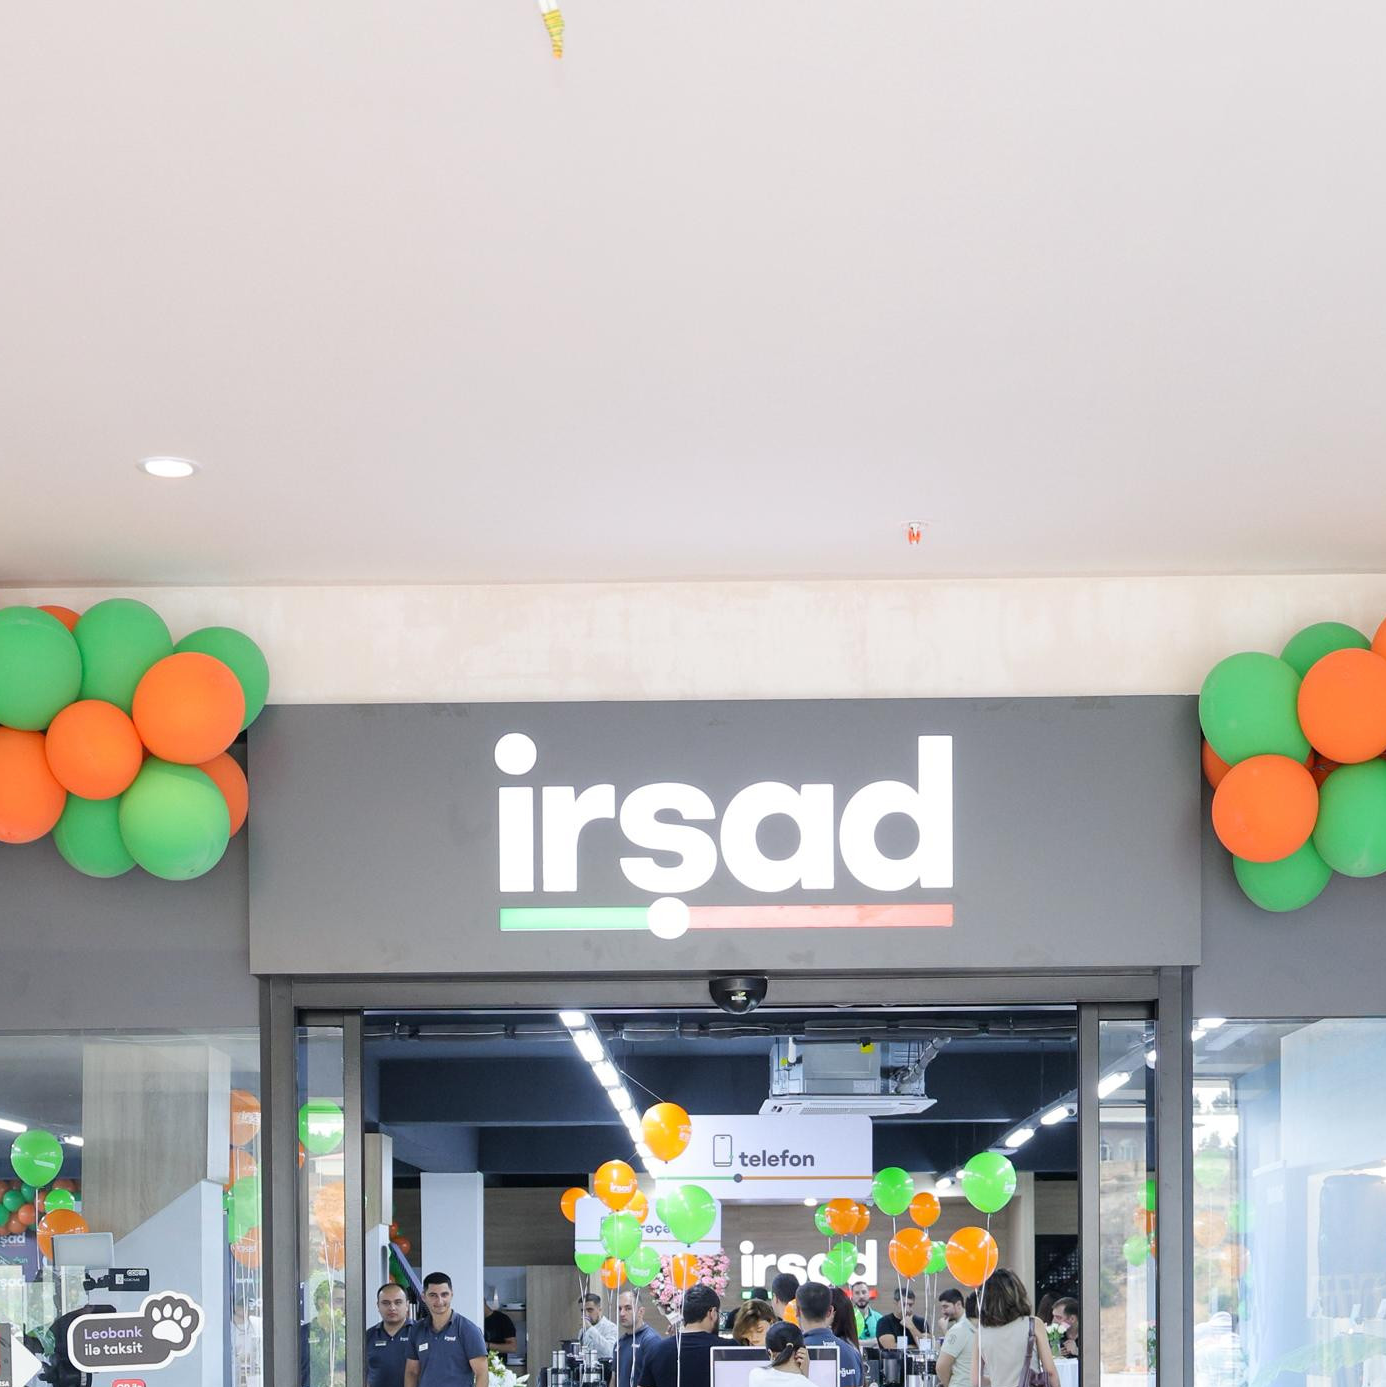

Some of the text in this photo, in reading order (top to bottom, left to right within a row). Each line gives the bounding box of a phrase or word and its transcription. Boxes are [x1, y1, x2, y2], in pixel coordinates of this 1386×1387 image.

[738, 1149, 815, 1167] telefon
[84, 1325, 143, 1340] Leobank
[84, 1341, 143, 1356] ilə taksit
